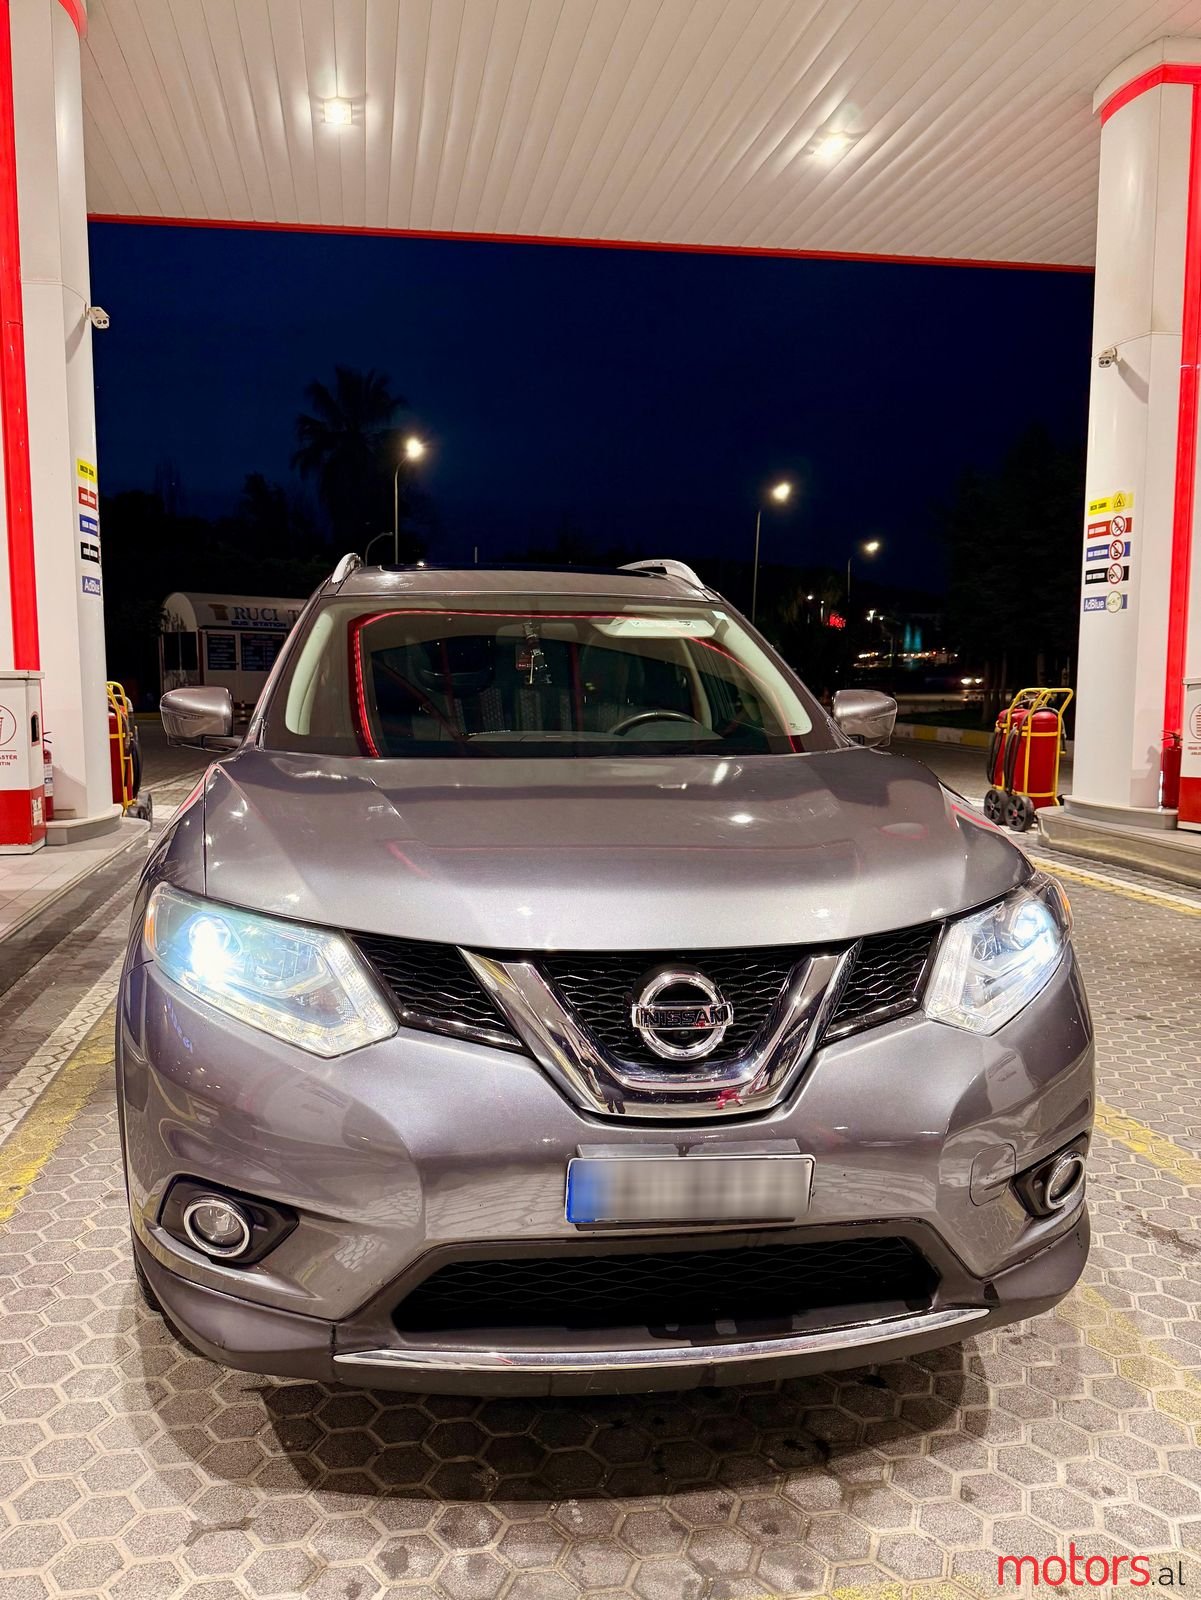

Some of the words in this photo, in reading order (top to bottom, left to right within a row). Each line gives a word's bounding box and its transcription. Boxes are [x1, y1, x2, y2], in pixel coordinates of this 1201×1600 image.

[1084, 598, 1105, 610] AdBlue
[232, 607, 280, 621] RUCI
[643, 1006, 727, 1025] NISSAN
